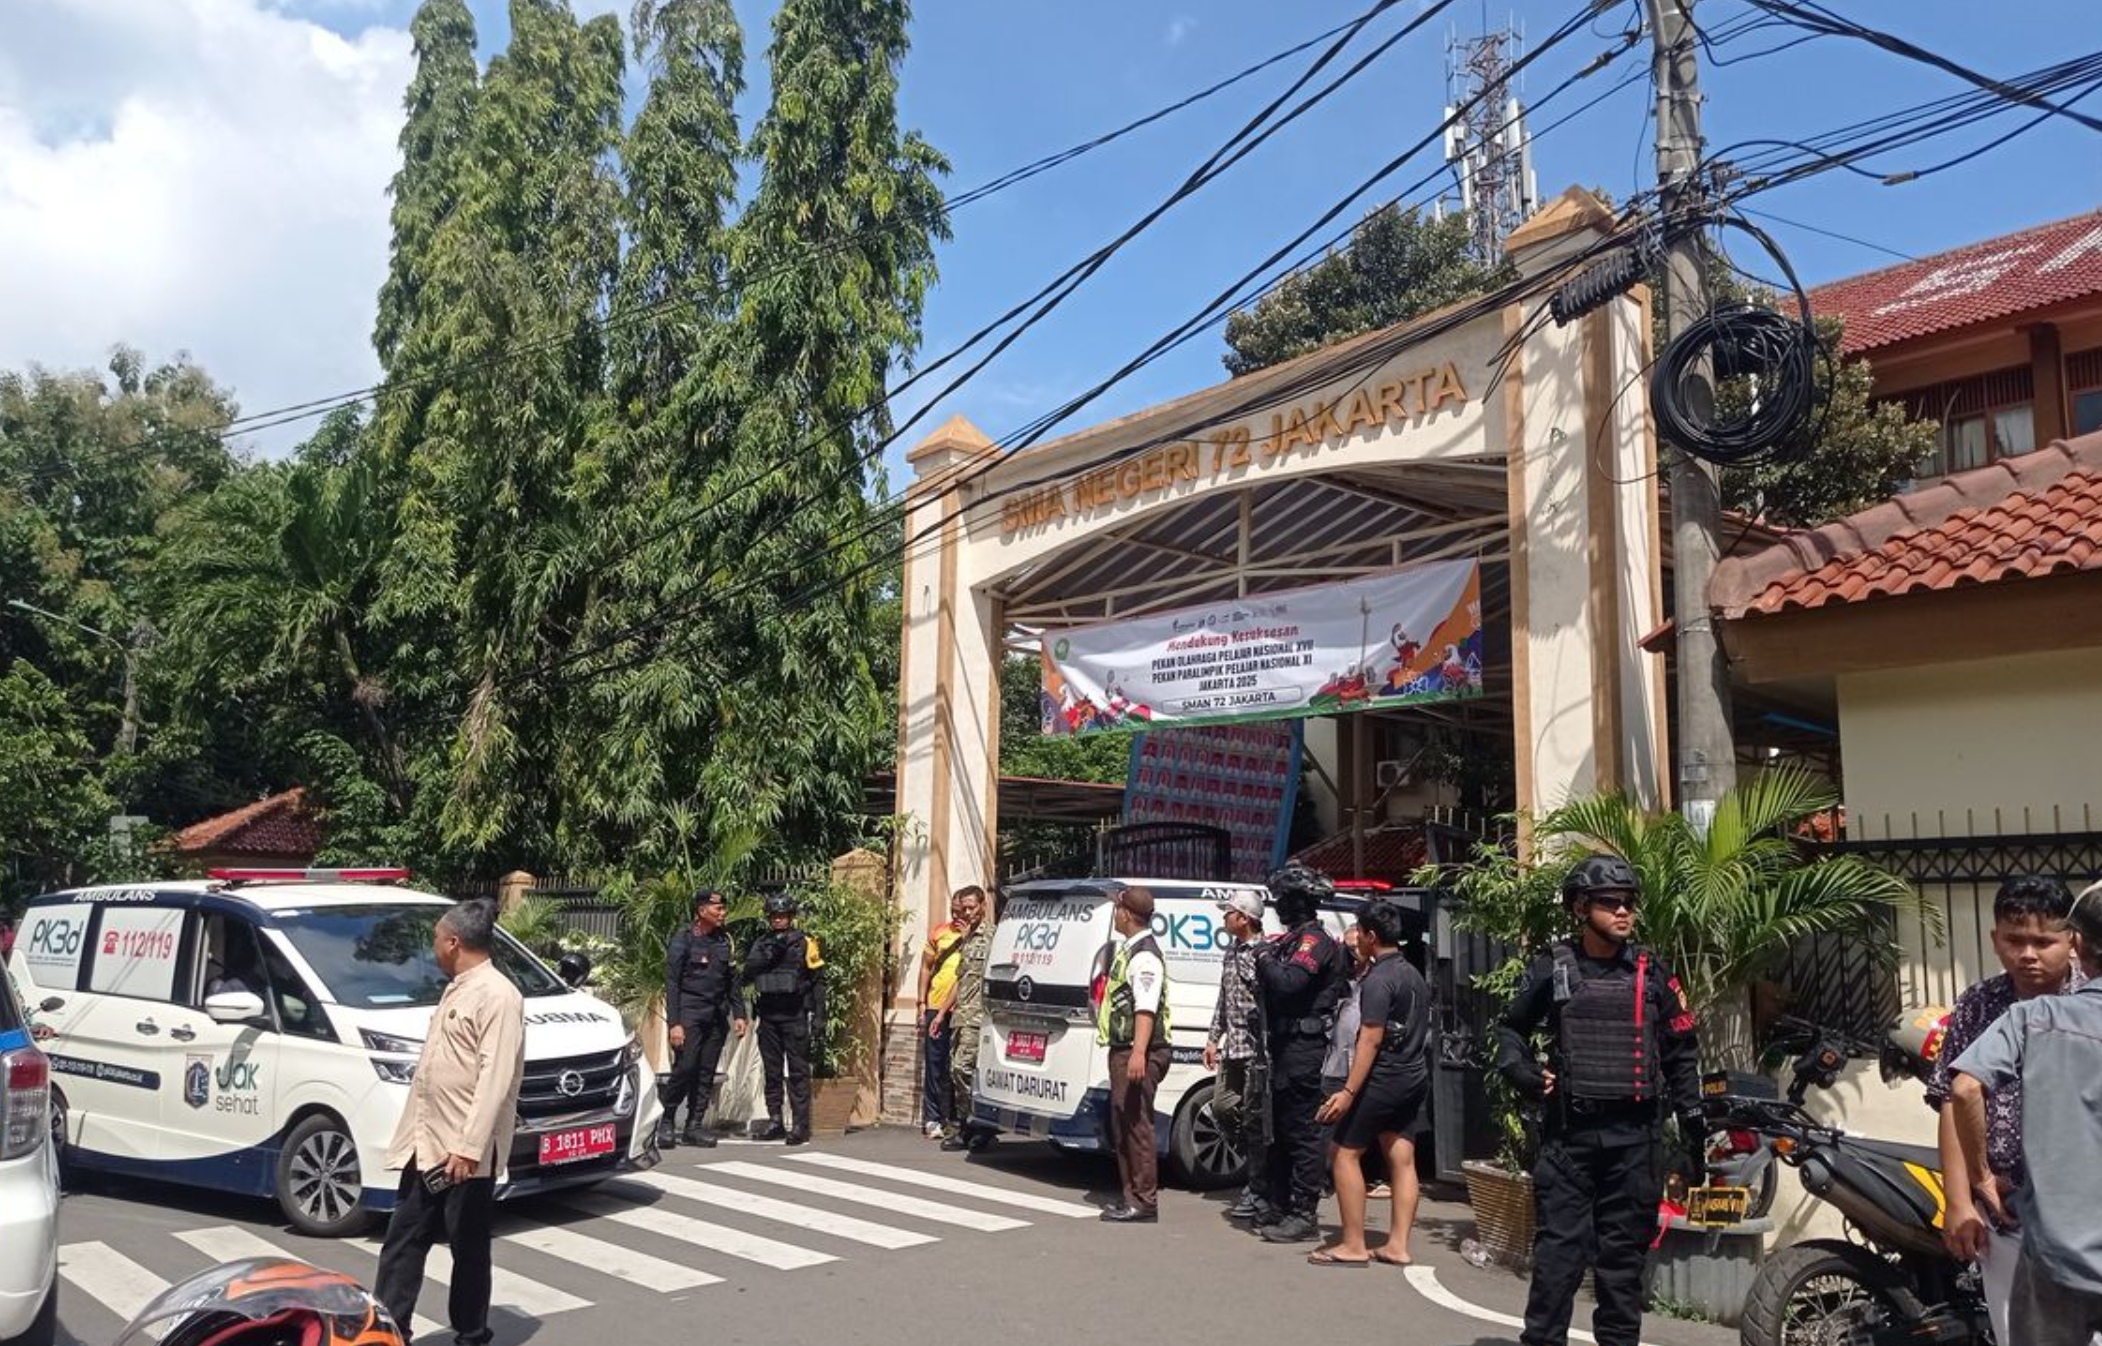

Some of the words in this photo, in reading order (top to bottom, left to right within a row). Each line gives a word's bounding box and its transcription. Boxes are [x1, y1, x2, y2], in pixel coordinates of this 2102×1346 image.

[1002, 485, 1066, 533] SMA
[1073, 442, 1199, 512] NEGERI
[1209, 425, 1251, 472] 72
[1260, 361, 1468, 456] JAKARTA
[1152, 656, 1176, 670] PEKAN
[1177, 652, 1217, 667] OLAHRAGA
[1218, 648, 1251, 662] PELAJAR
[1253, 643, 1294, 657] NASIONAL
[1152, 670, 1176, 684] PEKAN
[1178, 666, 1223, 681] PARALIMPIK
[1225, 661, 1258, 676] PELAJAR
[1260, 656, 1300, 671] NASIONAL
[1303, 654, 1313, 666] XI
[1199, 677, 1235, 691] JAKARTA
[1236, 675, 1258, 688] 2025
[1182, 699, 1211, 711] SMAN
[1214, 697, 1226, 707] 72
[1229, 692, 1277, 706] JAKARTA
[74, 889, 157, 902] AMBULANS
[1003, 902, 1095, 922] AMBULANS
[121, 930, 174, 959] 112/119
[1017, 1074, 1068, 1102] DARURAT
[215, 1094, 259, 1116] sehat
[543, 1137, 552, 1154] B
[556, 1131, 585, 1151] 1811
[590, 1127, 614, 1145] PHX
